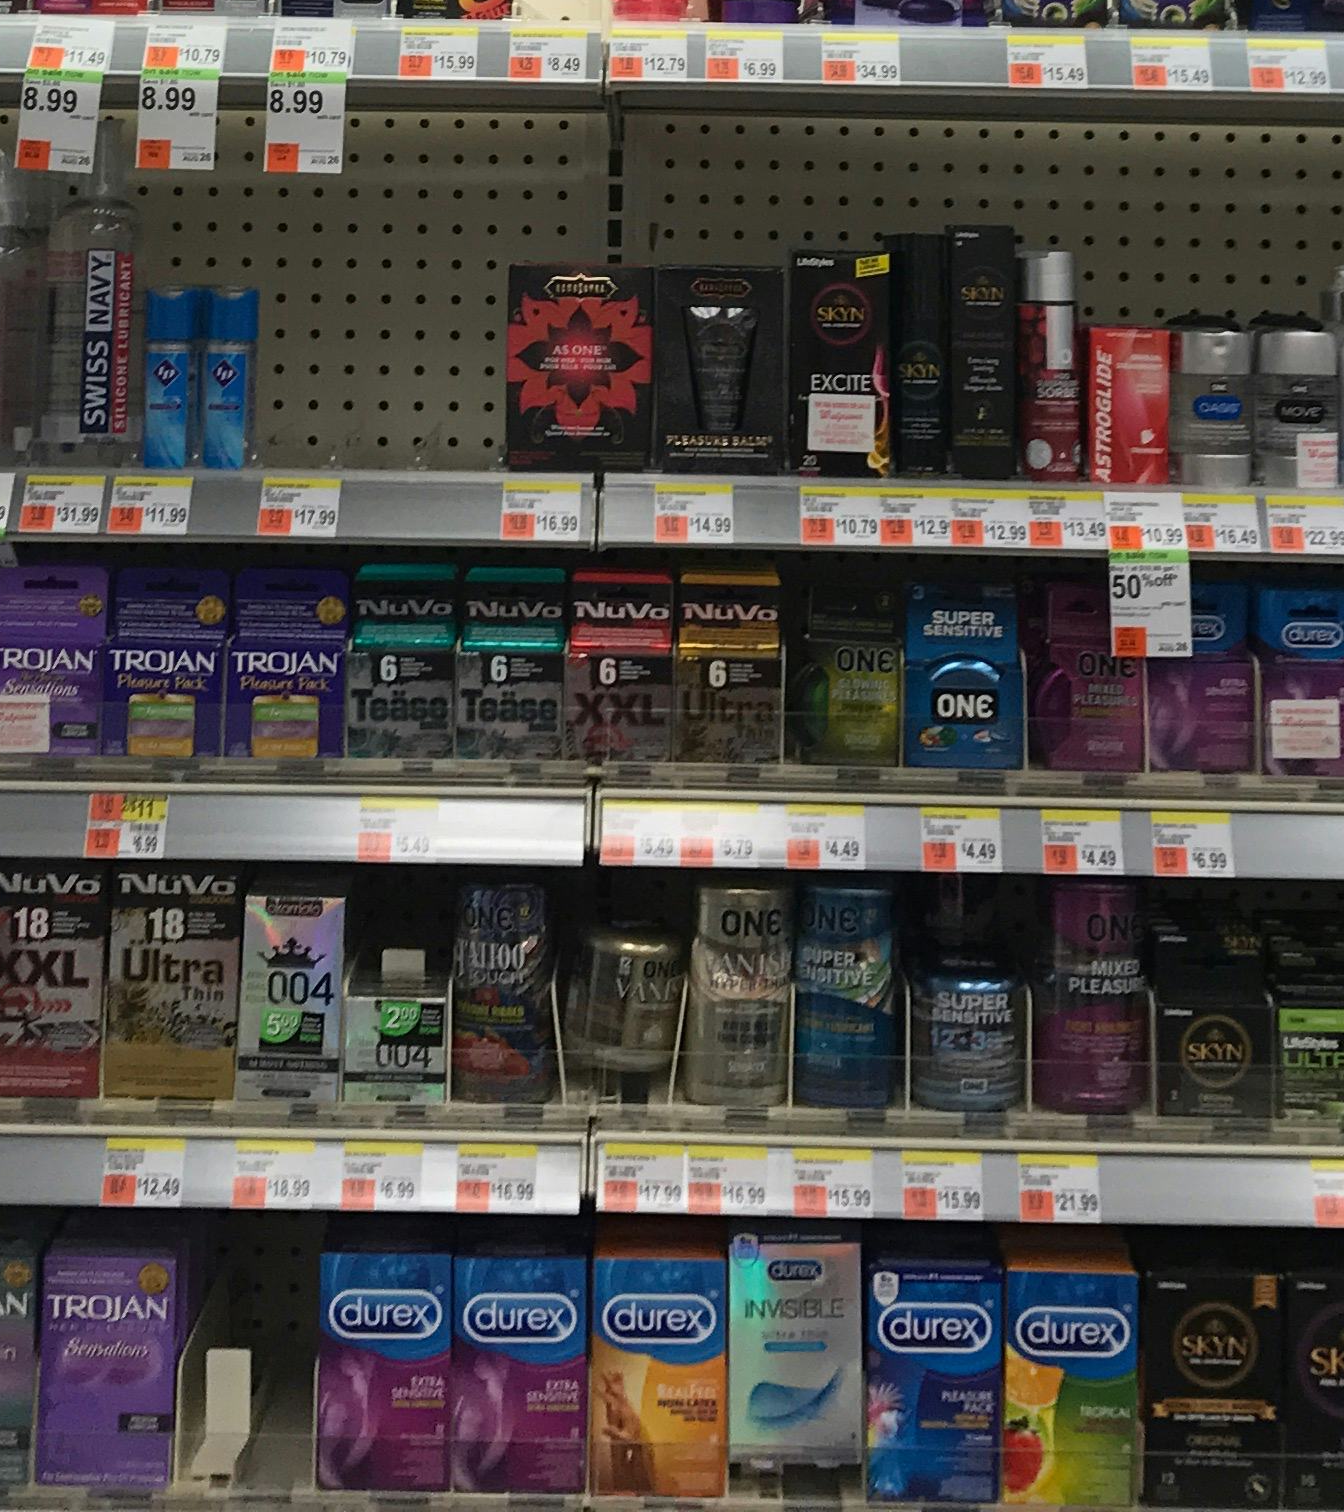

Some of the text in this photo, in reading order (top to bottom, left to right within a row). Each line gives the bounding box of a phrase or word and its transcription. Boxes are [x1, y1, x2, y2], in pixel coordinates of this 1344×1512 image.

[64, 50, 105, 65] $11.49
[306, 50, 346, 66] $10.79
[434, 55, 475, 70] $15.99
[547, 57, 580, 72] $8.49
[644, 57, 685, 72] $12.79
[23, 88, 78, 112] 8.99
[141, 87, 196, 111] 8.99
[270, 90, 323, 114] 8.99
[961, 286, 1004, 303] SKYN
[817, 306, 865, 323] SKYN
[83, 252, 115, 433] SWISS NAVY
[811, 374, 872, 392] EXCITE
[1094, 350, 1112, 483] ASTROGLIDE
[145, 505, 187, 524] $11.99
[295, 510, 336, 526] $17.99
[537, 515, 577, 532] $16.99
[690, 517, 731, 533] $14.99
[836, 518, 878, 535] $10.79
[985, 524, 1026, 542] $12.99
[1112, 576, 1140, 599] 50
[932, 610, 995, 625] SUPER
[923, 623, 1004, 639] SENSITIVE
[1289, 626, 1338, 647] durex
[109, 649, 216, 674] TROJAN
[232, 651, 339, 674] TROJAN
[380, 655, 397, 681] 6
[491, 656, 508, 682] 6
[599, 658, 617, 685] 6
[240, 676, 330, 692] Pleasure Pack
[709, 661, 727, 687] 6
[14, 908, 48, 939] 18
[149, 909, 183, 940] 18
[268, 971, 334, 1006] 004
[936, 992, 1008, 1011] SUPER
[1186, 1041, 1242, 1060] SKYN
[46, 1295, 168, 1320] TROJAN
[341, 1296, 430, 1328] durex
[475, 1301, 568, 1330] durex
[614, 1300, 704, 1333] durex
[744, 1298, 844, 1320] INVISIBLE
[889, 1309, 978, 1342] durex
[1027, 1313, 1116, 1346] durex
[1182, 1335, 1247, 1357] SKYN
